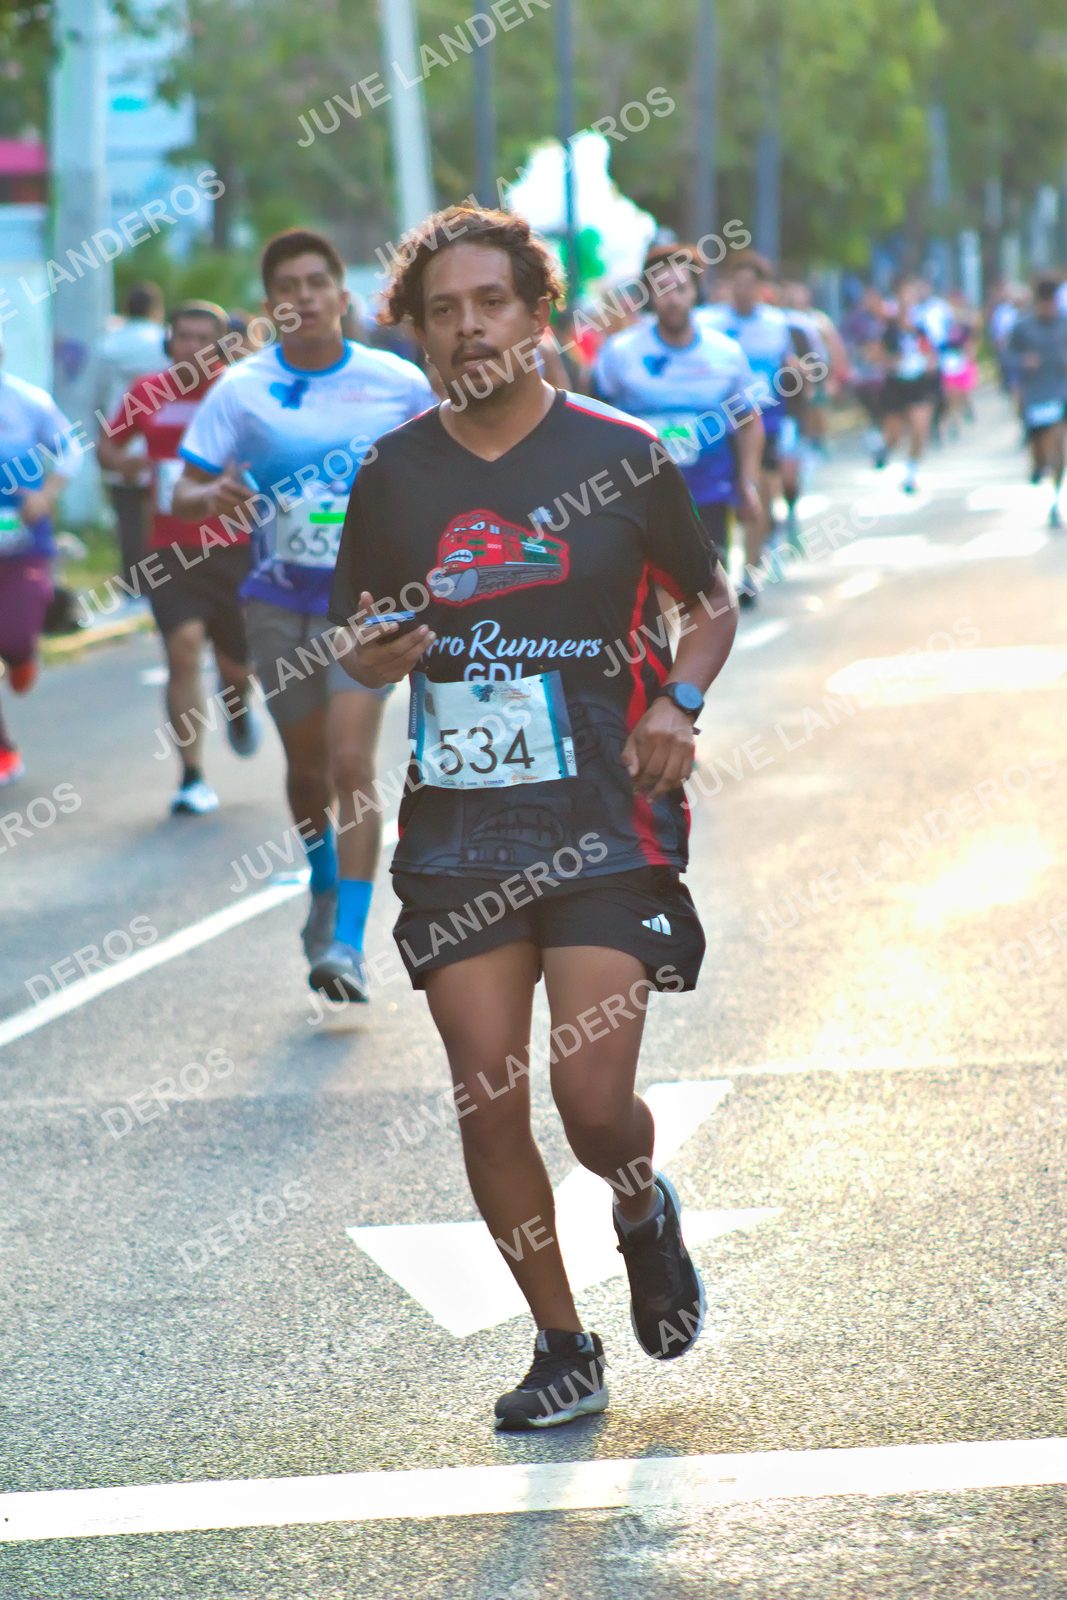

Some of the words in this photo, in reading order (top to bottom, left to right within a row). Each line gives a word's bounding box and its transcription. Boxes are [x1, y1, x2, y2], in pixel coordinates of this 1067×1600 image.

[426, 635, 466, 657] rro
[469, 619, 602, 660] Runners
[440, 726, 535, 775] 534
